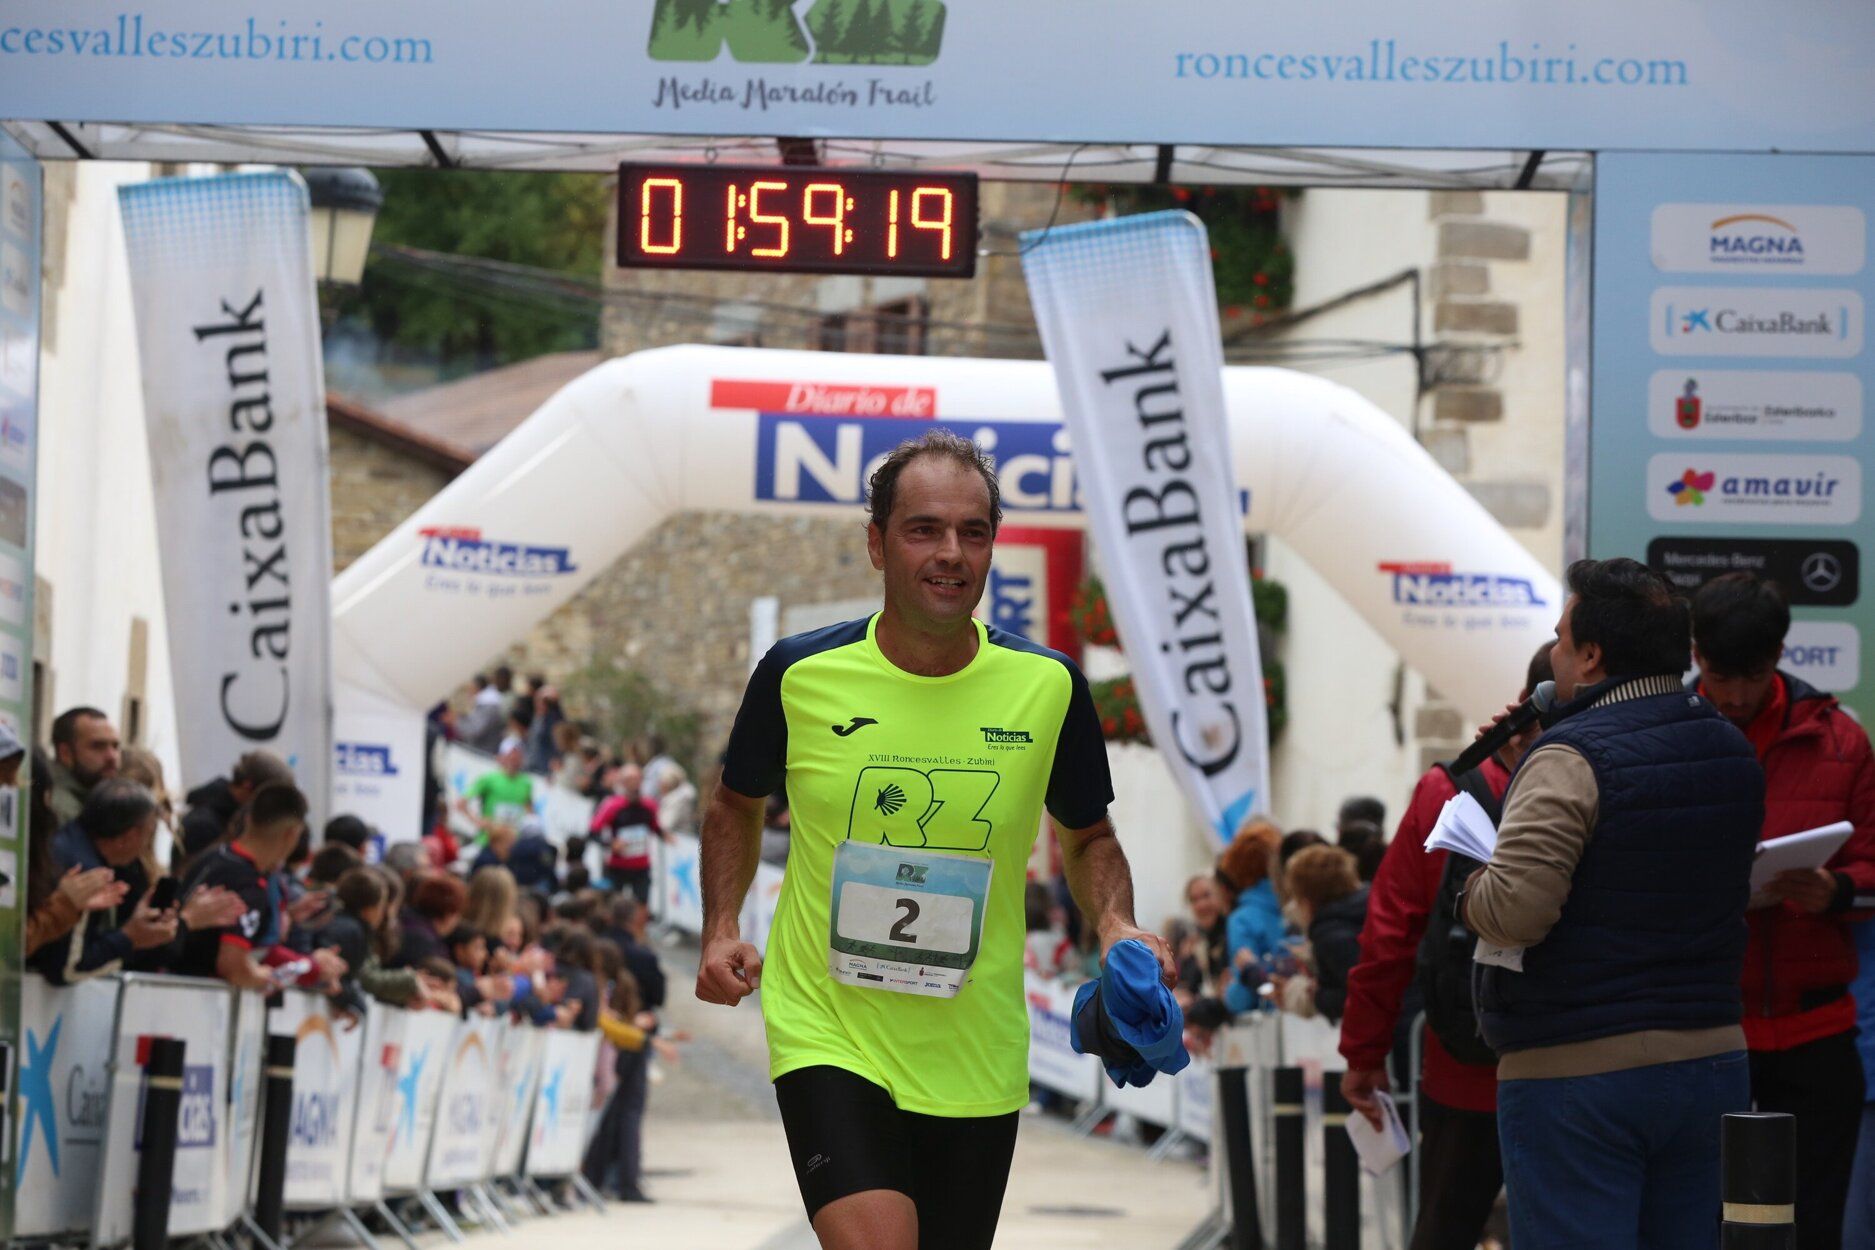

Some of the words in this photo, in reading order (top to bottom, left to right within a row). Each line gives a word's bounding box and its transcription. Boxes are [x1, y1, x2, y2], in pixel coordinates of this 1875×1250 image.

[0, 14, 434, 63] cesvalleszubiri.com
[1174, 38, 1689, 86] roncesvalleszubiri.com
[653, 77, 735, 109] Media
[866, 78, 936, 108] Trail
[1710, 236, 1804, 254] MAGNA
[1715, 309, 1832, 335] CaixaBank
[785, 384, 888, 416] Diario
[890, 386, 931, 418] de
[1721, 471, 1840, 497] amavir
[192, 287, 291, 742] CaixaBank
[428, 537, 560, 574] Noticias
[1099, 327, 1242, 779] CaixaBank
[1399, 574, 1530, 606] Noticias
[987, 732, 1027, 743] Noticias
[868, 754, 890, 763] XVIII
[892, 755, 961, 765] Roncesvalles
[967, 757, 995, 766] Zubiri
[847, 766, 1000, 851] RZ
[888, 898, 920, 944] 2
